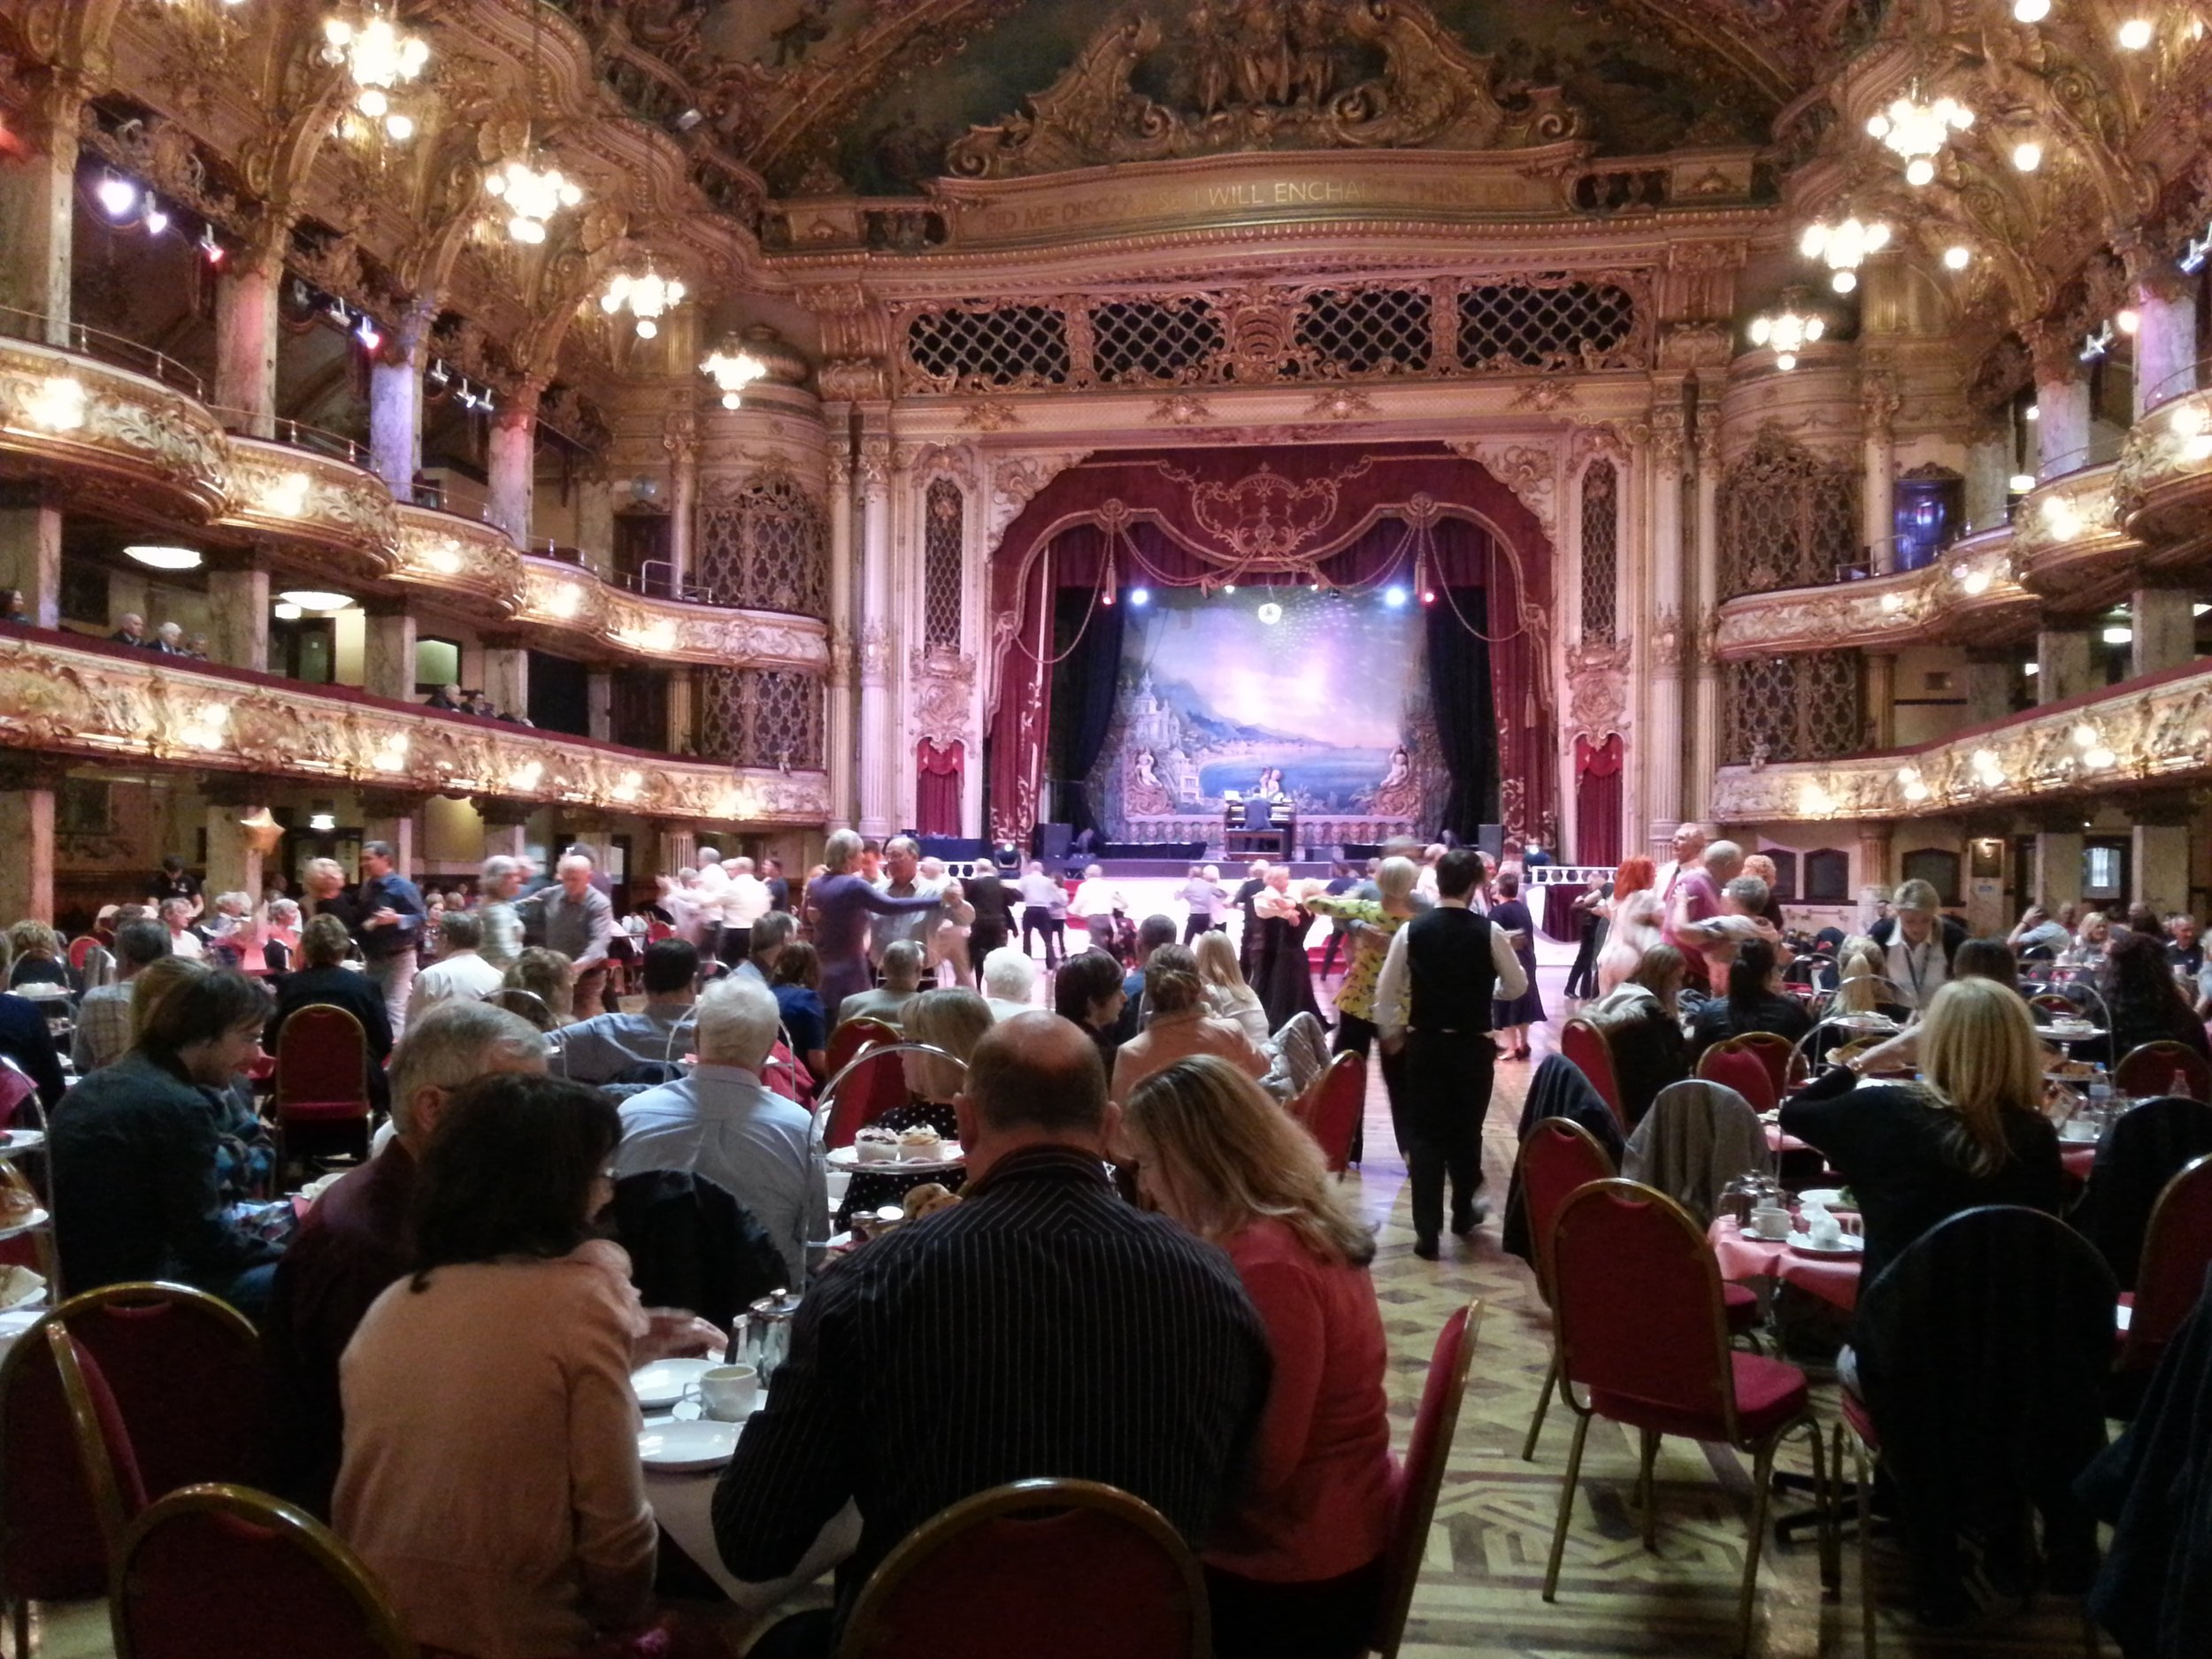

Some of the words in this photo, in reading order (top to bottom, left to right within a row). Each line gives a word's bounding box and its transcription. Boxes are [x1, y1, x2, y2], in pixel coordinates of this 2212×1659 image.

[1025, 205, 1054, 227] ME
[1209, 184, 1264, 205] WILL
[1274, 180, 1395, 203] ENCHAN
